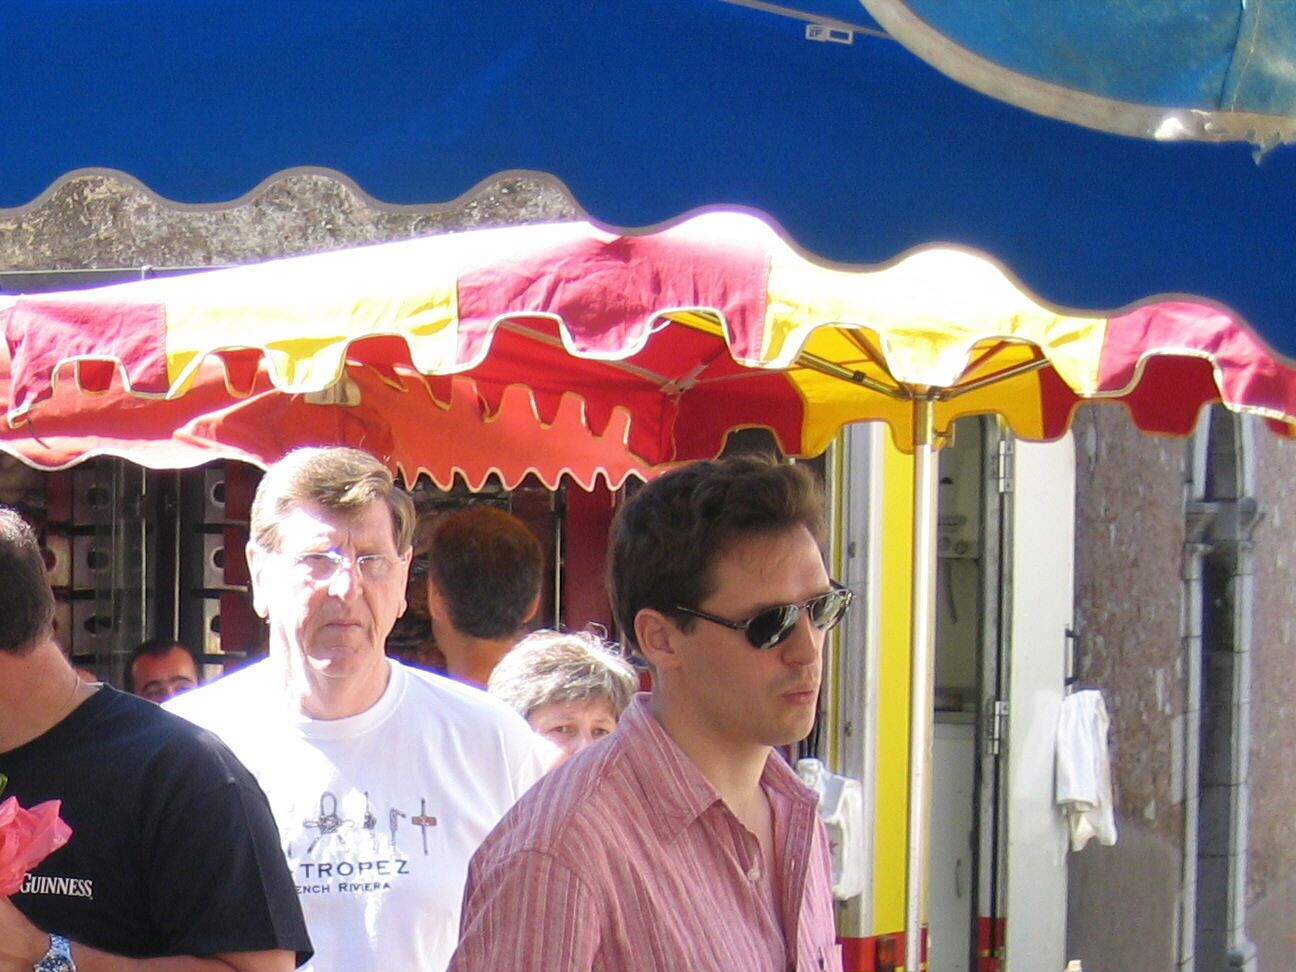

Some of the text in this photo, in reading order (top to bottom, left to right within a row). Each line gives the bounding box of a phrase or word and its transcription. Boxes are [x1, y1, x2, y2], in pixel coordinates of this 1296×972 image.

[300, 860, 410, 878] TROPEZ
[20, 873, 93, 897] GUINNESS
[338, 881, 391, 893] RIVIERA
